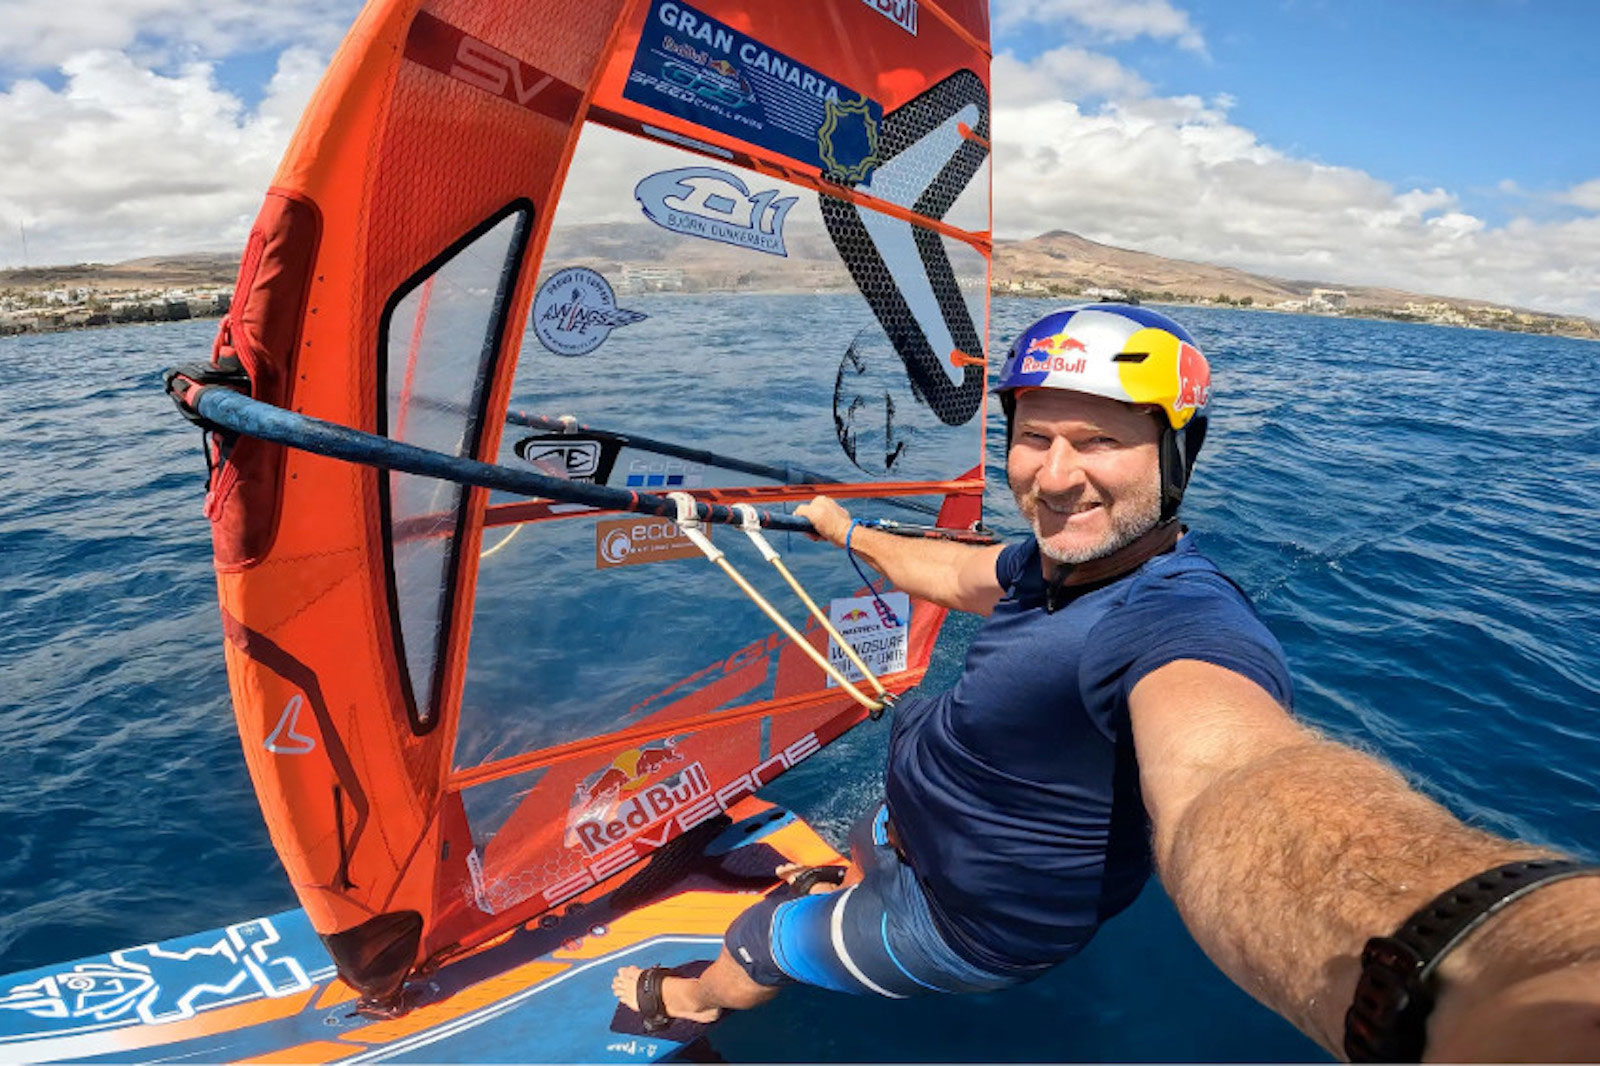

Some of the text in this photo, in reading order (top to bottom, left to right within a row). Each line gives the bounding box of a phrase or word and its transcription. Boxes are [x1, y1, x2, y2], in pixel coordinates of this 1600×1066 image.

[451, 36, 555, 105] SV
[630, 70, 695, 103] SPEED
[659, 2, 734, 54] GRAN
[740, 43, 839, 104] CANARIA
[711, 224, 780, 249] DUNKERBECK
[1022, 356, 1087, 374] Red Bull
[543, 732, 821, 908] SEVERNE
[575, 764, 709, 853] Red Bull
